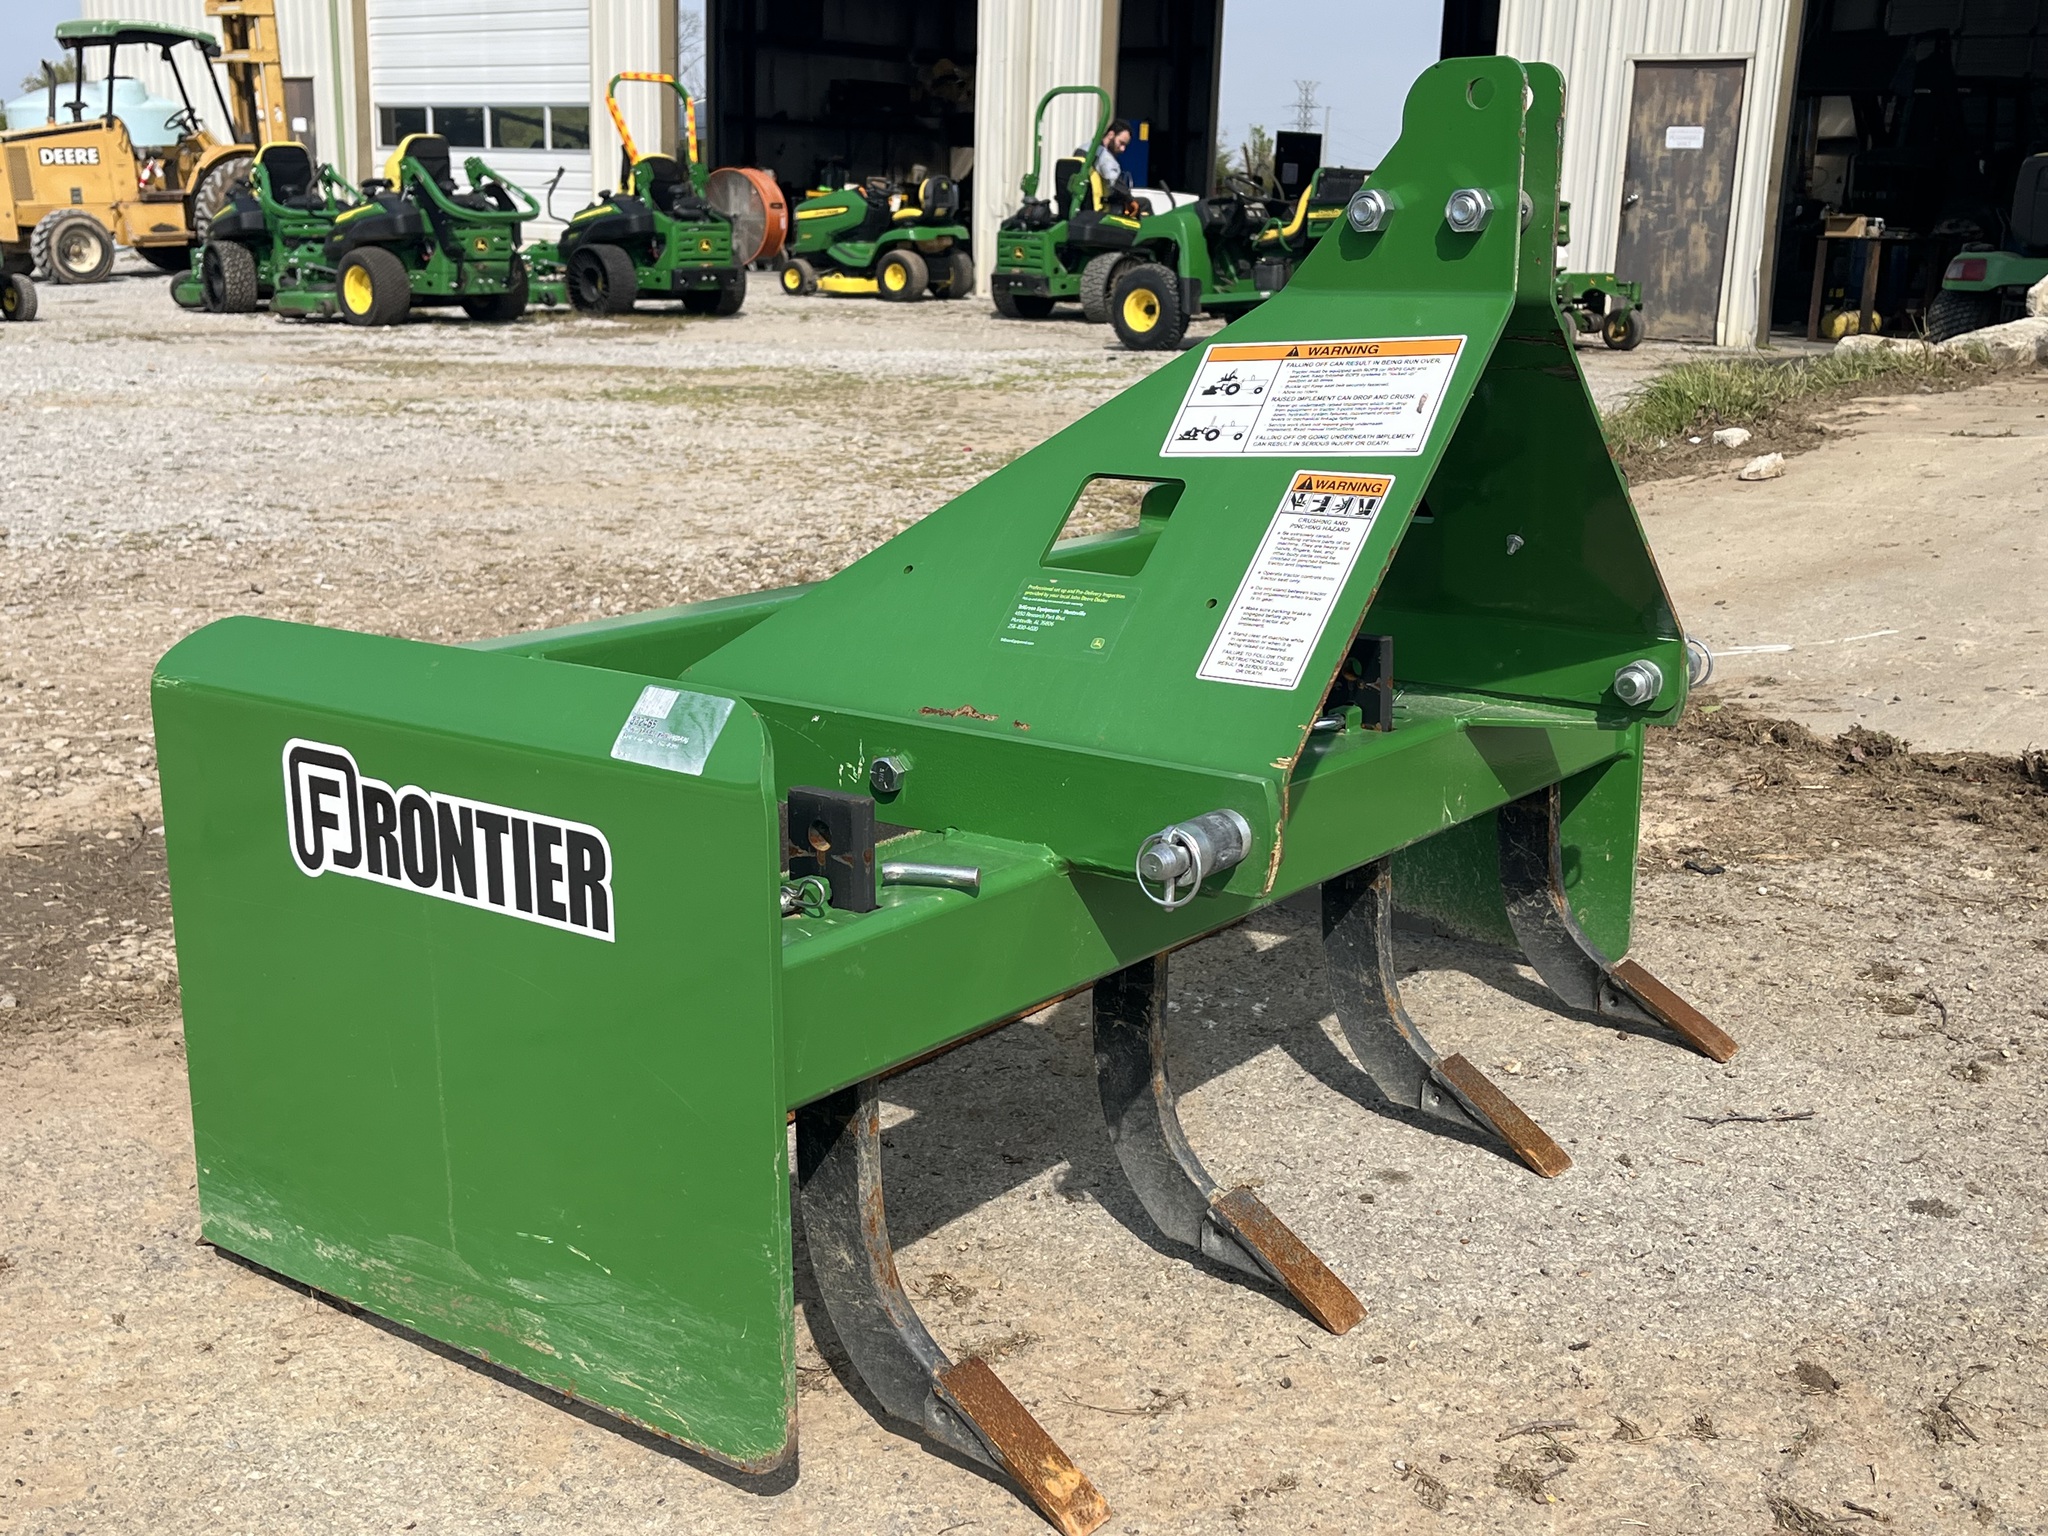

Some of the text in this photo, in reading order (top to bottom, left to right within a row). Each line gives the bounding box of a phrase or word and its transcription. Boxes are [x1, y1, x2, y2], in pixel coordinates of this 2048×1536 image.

[40, 148, 100, 165] DEERE
[1308, 345, 1379, 356] WARNING
[1315, 480, 1383, 493] WARNING
[1298, 517, 1331, 525] CRUSHING
[288, 745, 609, 933] FRONTIER
